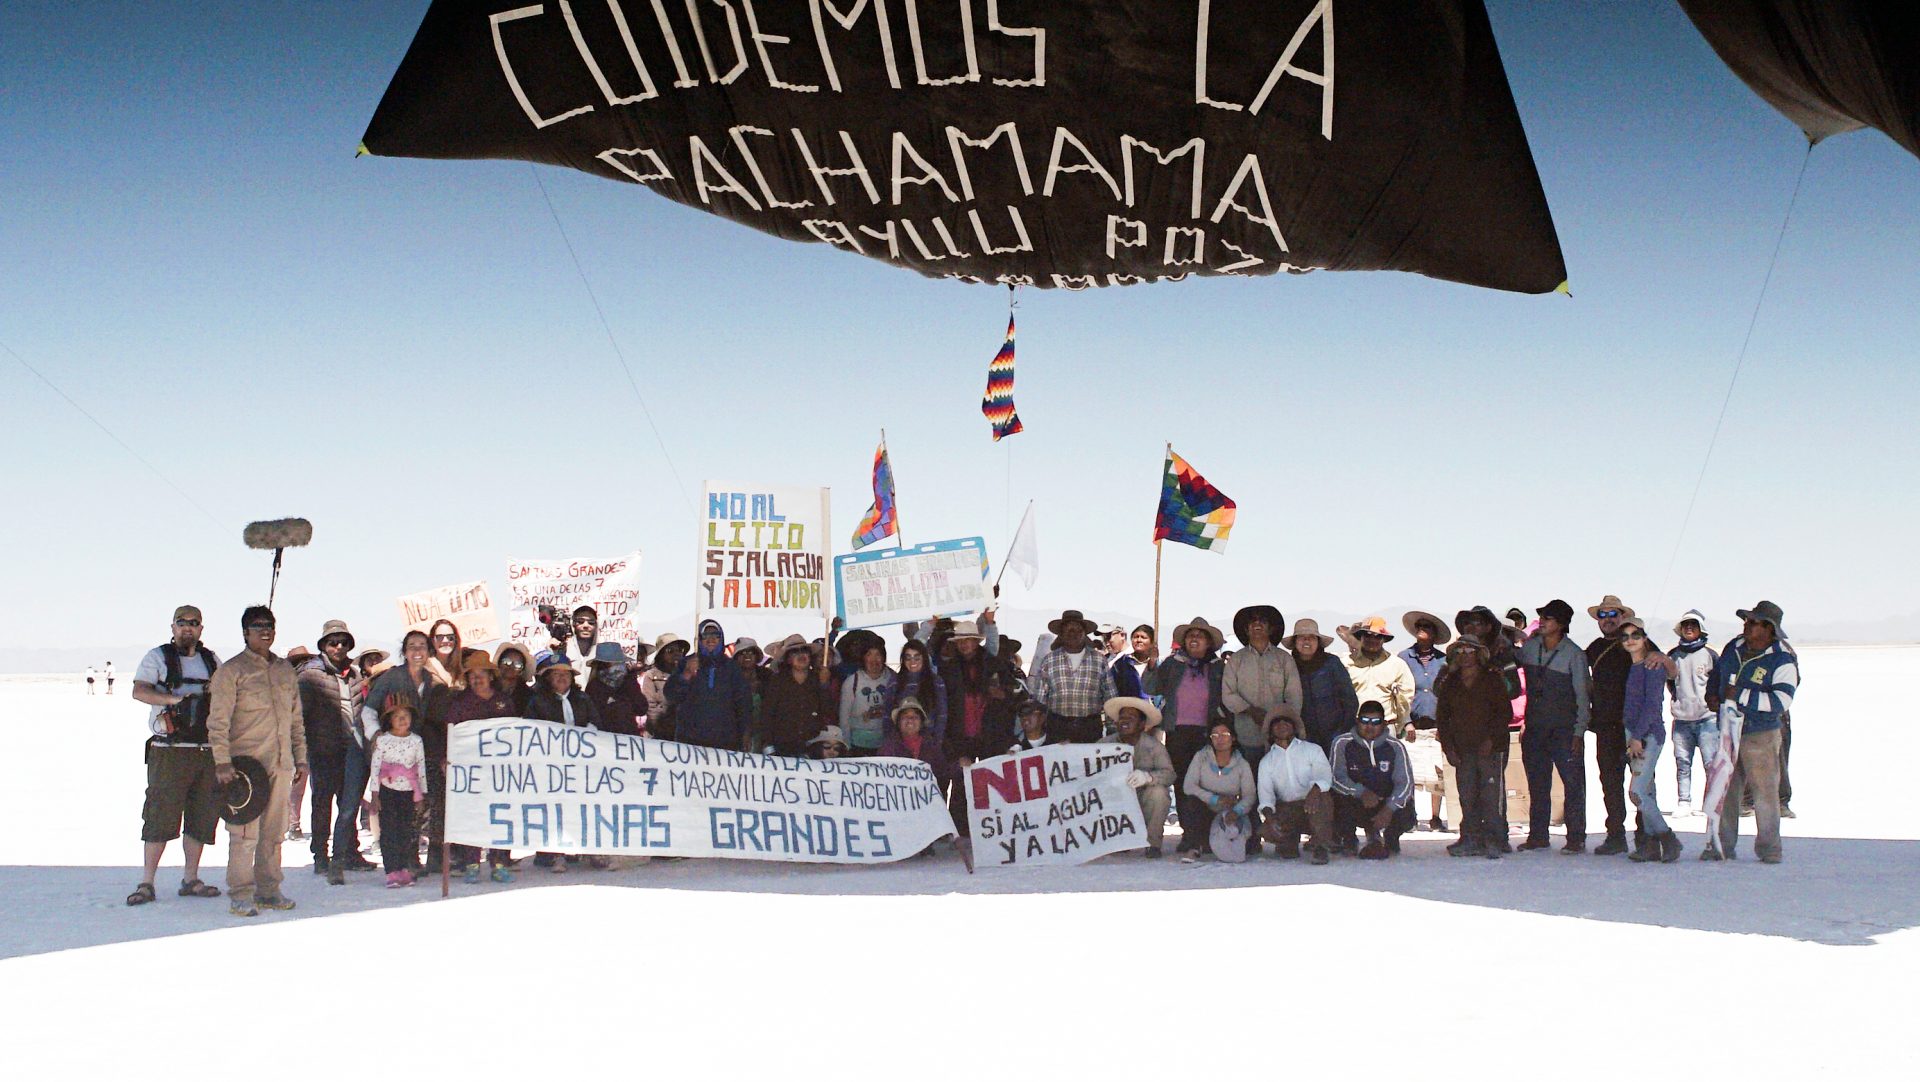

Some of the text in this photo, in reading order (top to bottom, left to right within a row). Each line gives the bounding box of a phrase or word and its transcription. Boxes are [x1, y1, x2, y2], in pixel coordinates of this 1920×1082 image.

[1195, 0, 1334, 141] LA
[596, 122, 1289, 252] PACHAMAMA
[709, 492, 786, 521] NO AL
[708, 521, 804, 550] LITIO
[568, 561, 627, 578] GRANDES
[706, 549, 824, 580] SI AL AGUA
[846, 557, 910, 583] SALINAS
[534, 584, 556, 596] UNA
[702, 578, 715, 609] Y
[723, 579, 739, 608] A
[778, 580, 821, 609] VIDA
[863, 570, 950, 597] NO AL LITIO
[403, 599, 429, 625] NO
[847, 598, 864, 616] SI
[866, 596, 884, 614] AL
[511, 622, 530, 638] SI
[479, 725, 598, 759] ESTAMOS
[614, 734, 647, 763] EN
[660, 741, 757, 769] CONTRA
[451, 763, 943, 812] DE UNA DE LAS 7 MARAVILLAS DE ARGENTINA
[970, 754, 1049, 810] NO
[1049, 760, 1077, 787] AL
[1012, 812, 1039, 835] AL
[1046, 788, 1104, 827] AGUA
[489, 802, 893, 857] SALINAS GRANDES
[1000, 837, 1016, 865] Y
[1027, 835, 1044, 858] A
[1051, 827, 1080, 855] LA
